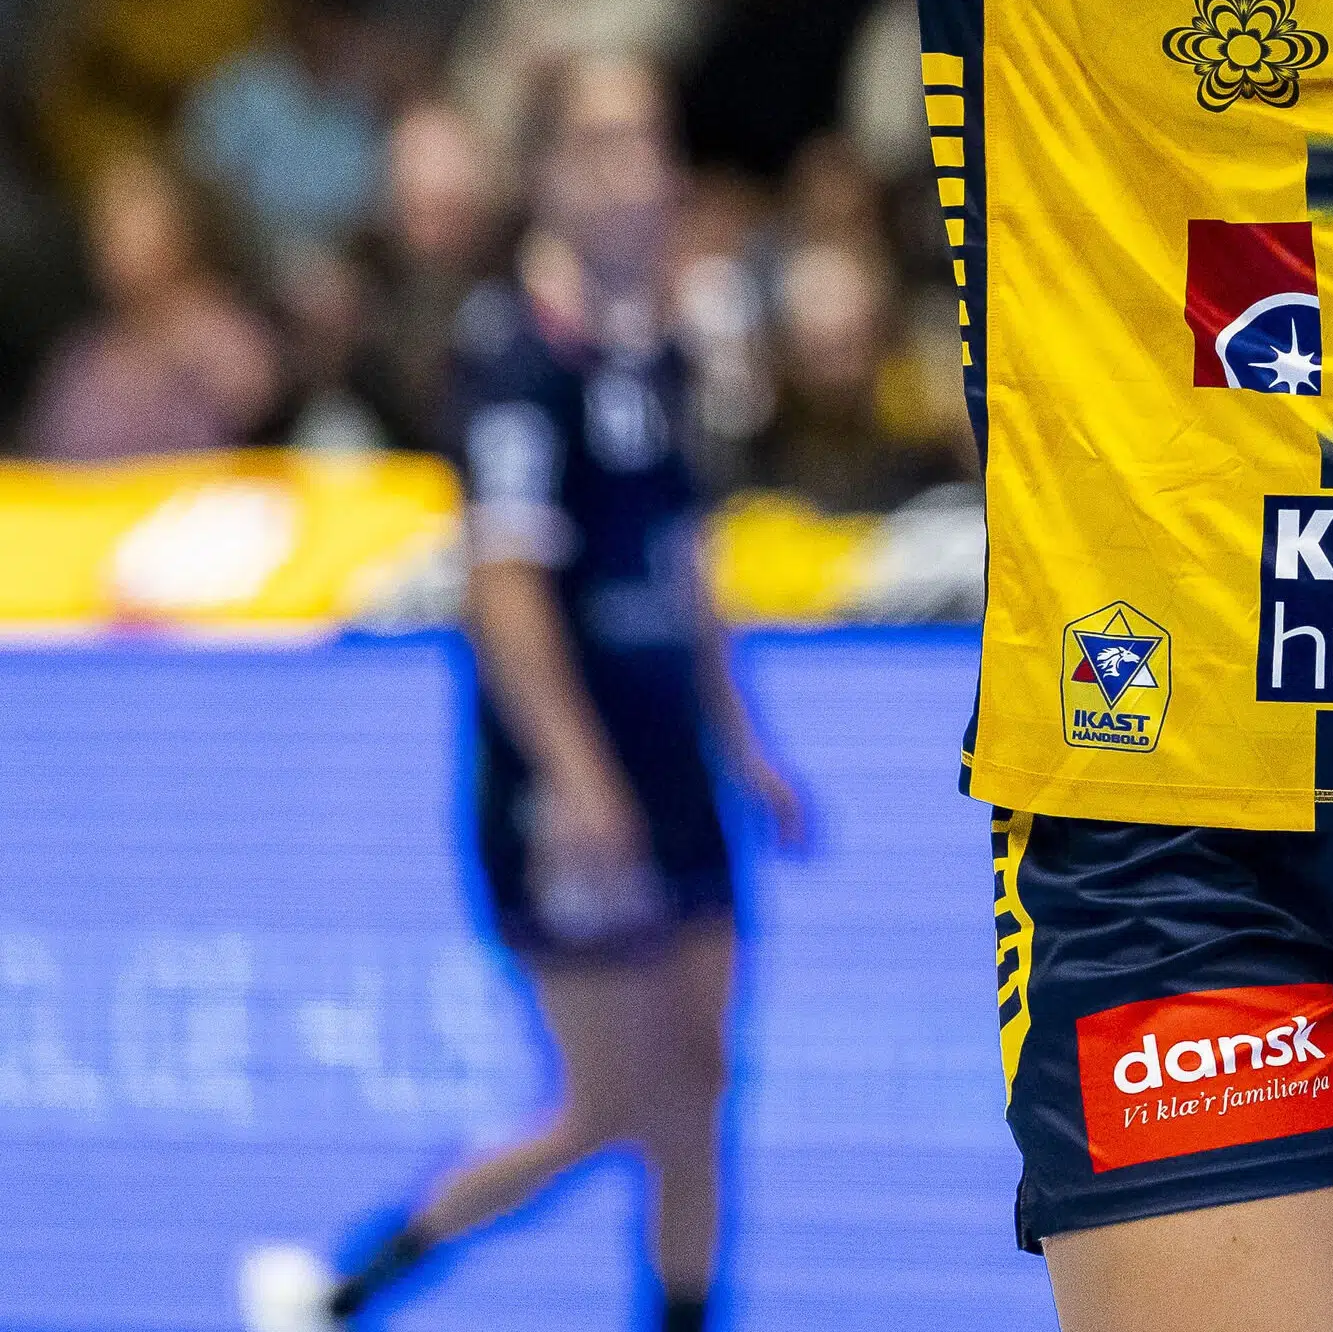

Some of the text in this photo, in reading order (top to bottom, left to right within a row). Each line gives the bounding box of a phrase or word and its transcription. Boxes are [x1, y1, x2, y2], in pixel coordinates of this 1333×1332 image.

[1074, 709, 1151, 732] IKAST
[1113, 1015, 1326, 1095] dansk
[1123, 1102, 1150, 1129] Vi
[1217, 1077, 1309, 1116] familien
